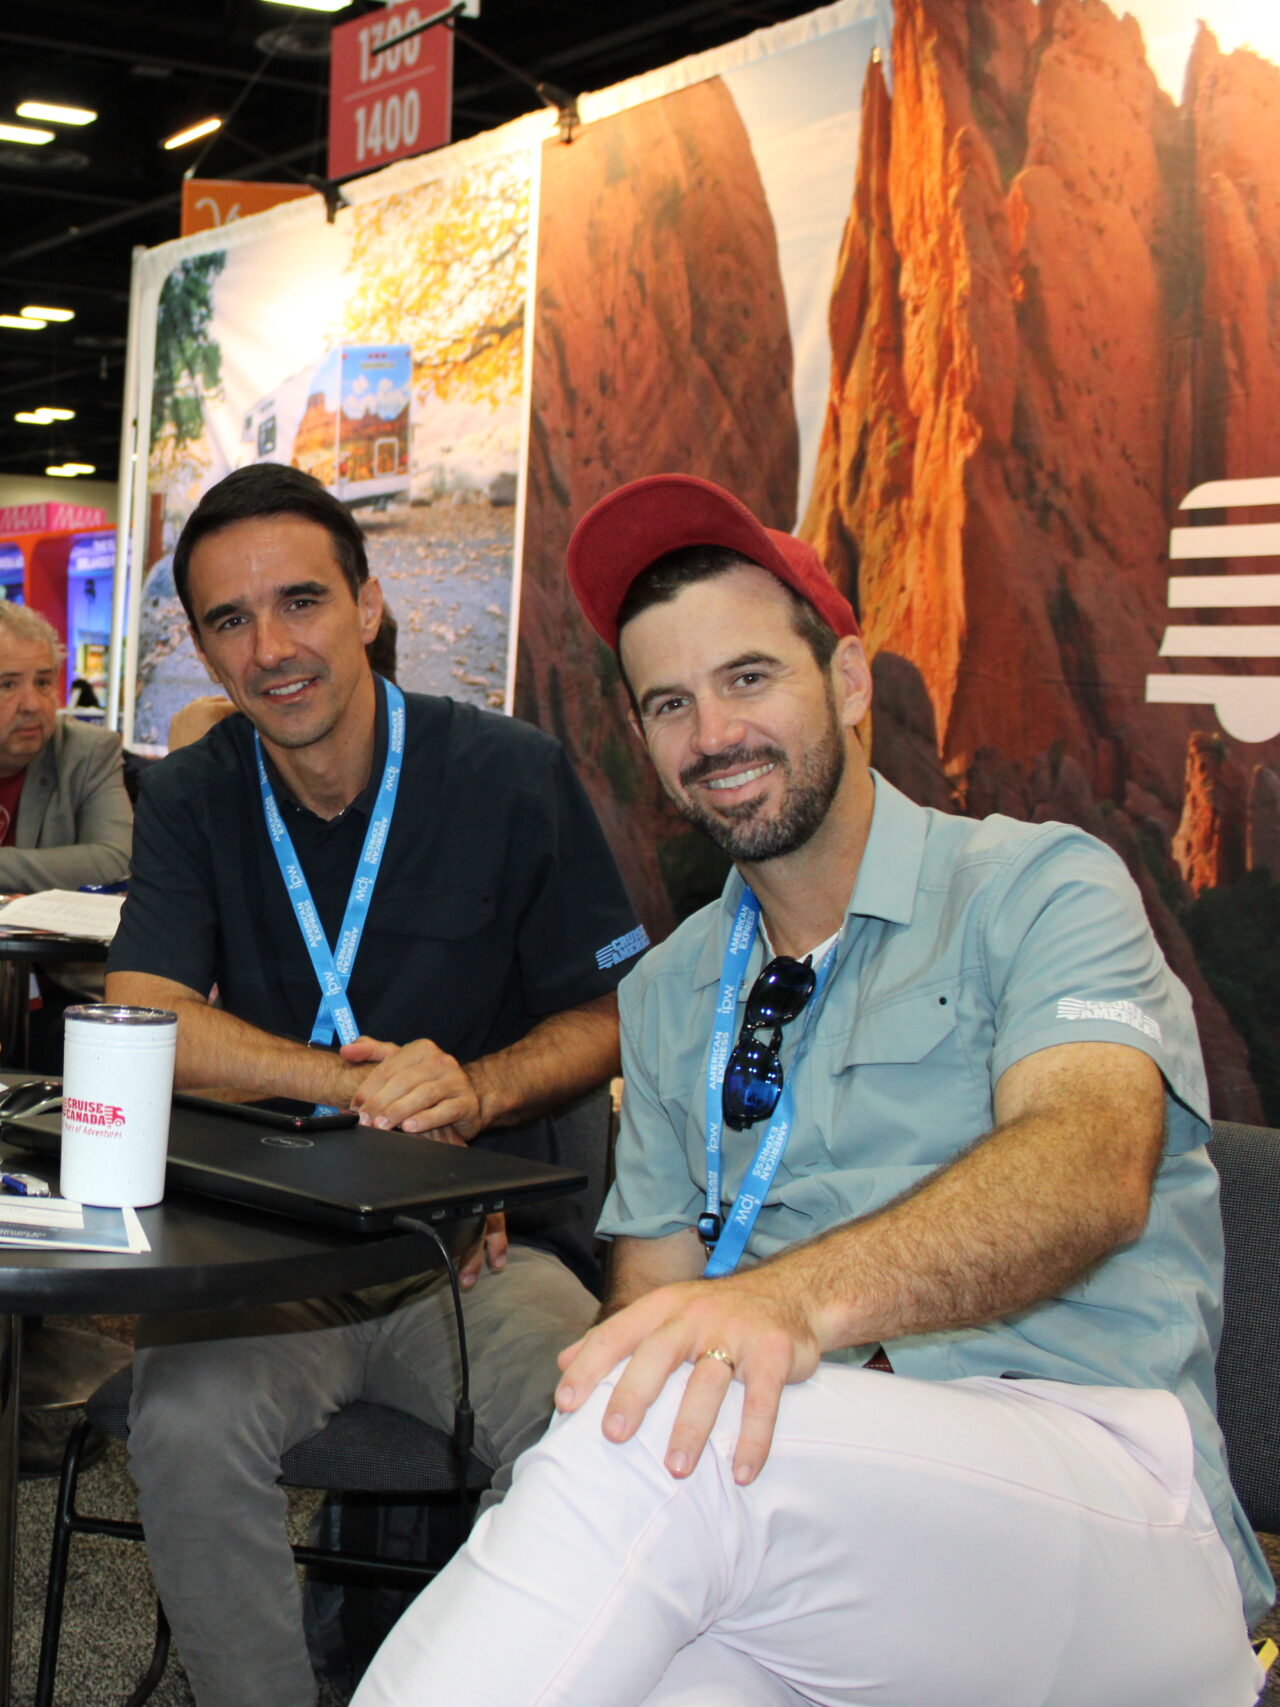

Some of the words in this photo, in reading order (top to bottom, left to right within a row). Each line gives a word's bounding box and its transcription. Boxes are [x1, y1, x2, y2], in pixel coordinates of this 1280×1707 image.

[358, 8, 420, 83] 1300
[355, 88, 419, 161] 1400
[730, 904, 750, 955] AMERICAN
[739, 910, 756, 950] EXPRESS
[717, 984, 735, 1014] ipw
[709, 1031, 723, 1090] AMERICAN
[717, 1031, 730, 1084] EXPRESS
[66, 1109, 106, 1125] CANADA
[68, 1098, 104, 1114] CRUISE
[83, 1126, 122, 1138] Adventures
[706, 1122, 719, 1153] ipw
[752, 1126, 778, 1176] EXPRESS
[760, 1121, 788, 1180] AMERICAN
[736, 1194, 761, 1226] ipw
